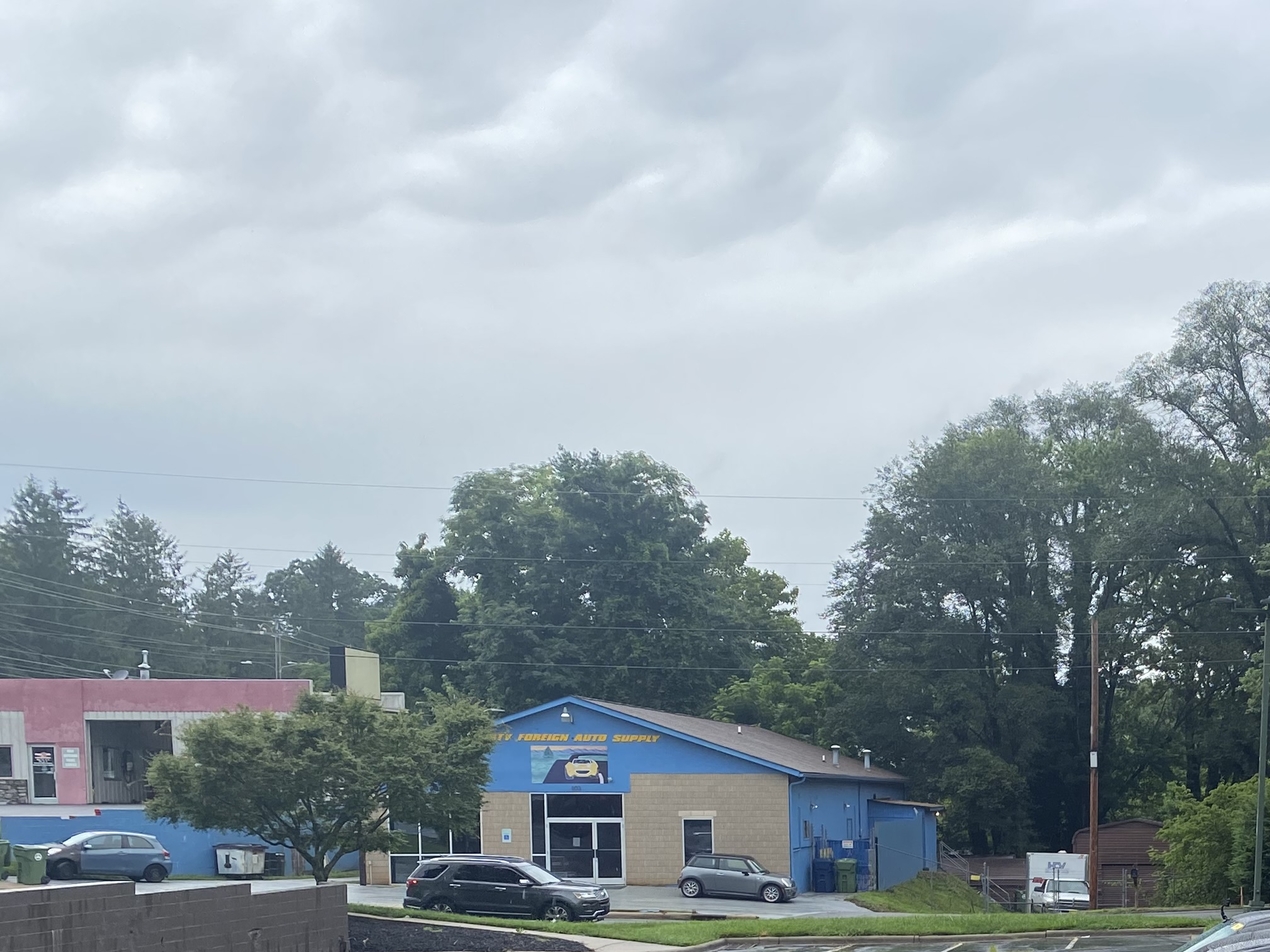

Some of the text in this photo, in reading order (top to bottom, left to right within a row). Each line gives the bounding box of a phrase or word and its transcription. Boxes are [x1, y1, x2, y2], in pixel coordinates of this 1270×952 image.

[517, 733, 569, 741] FOREIGN
[573, 733, 608, 742] AUTO
[612, 734, 660, 742] SUPPLY
